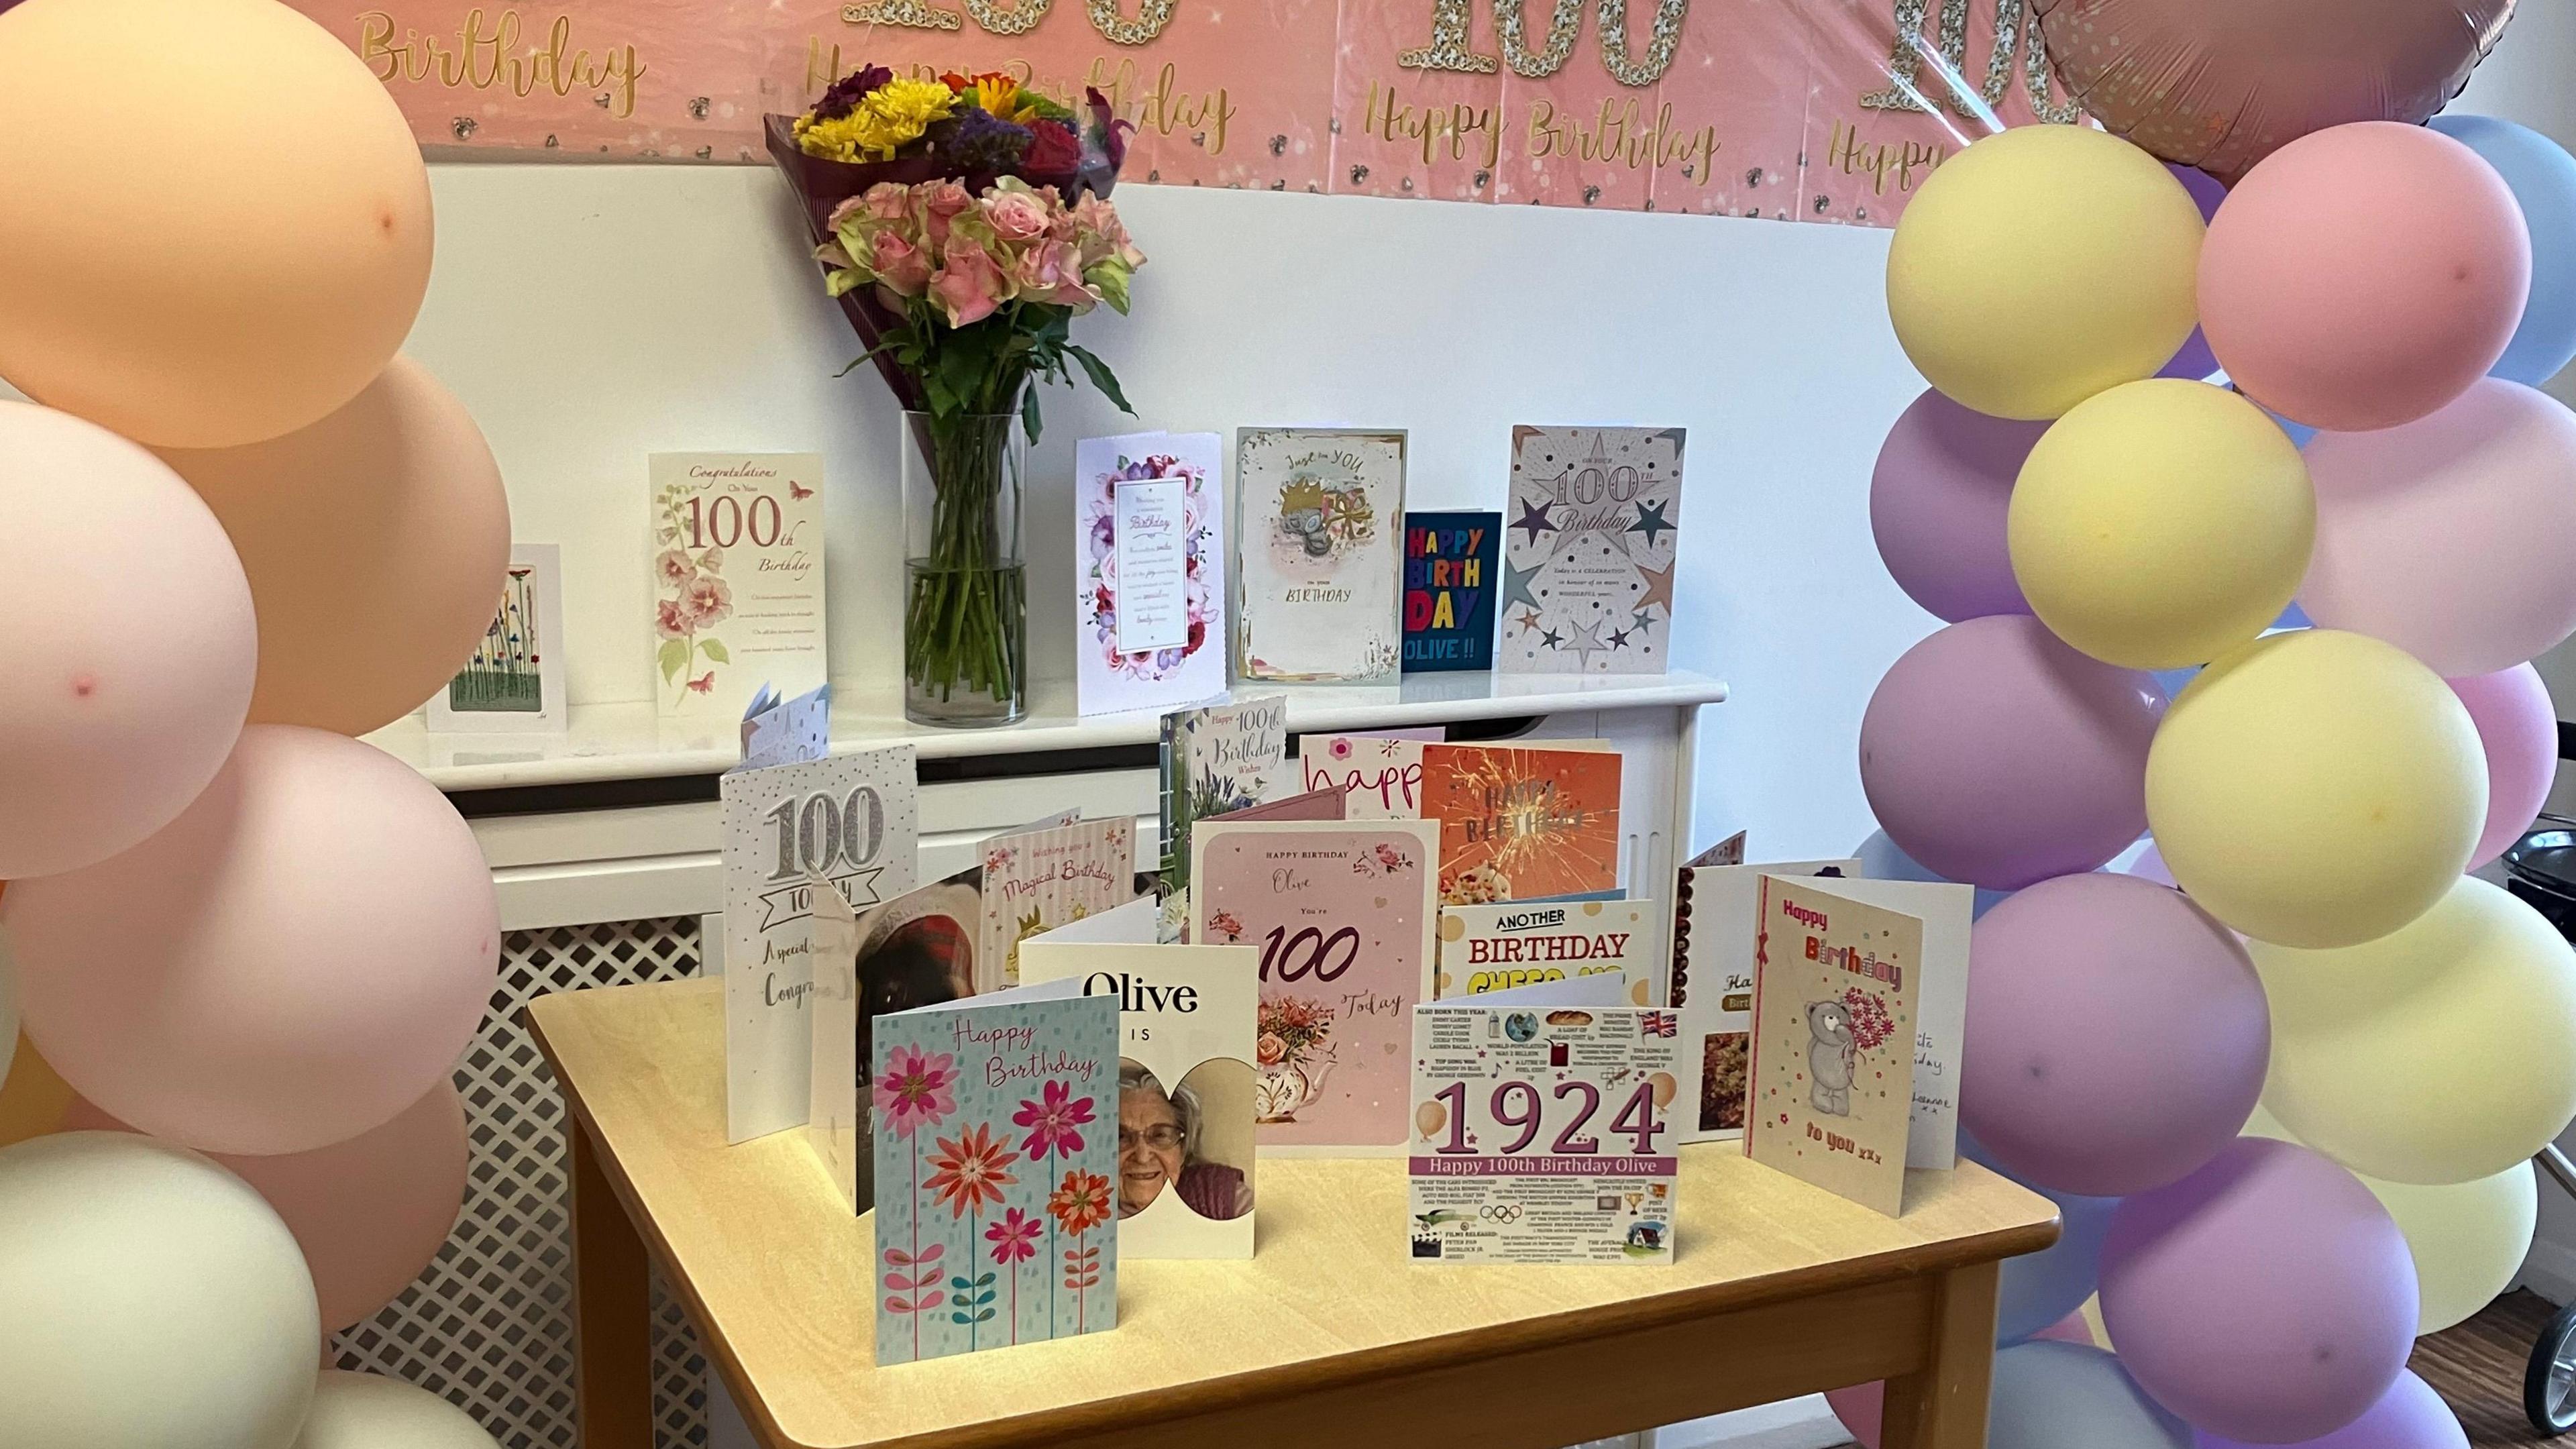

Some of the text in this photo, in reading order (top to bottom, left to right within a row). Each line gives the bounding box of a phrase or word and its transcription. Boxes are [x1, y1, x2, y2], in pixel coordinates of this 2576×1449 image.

[355, 9, 647, 119] Birthday
[1366, 80, 1722, 186] Happy Birthday
[690, 461, 777, 489] Congratulations
[1285, 451, 1315, 470] Just
[1331, 449, 1364, 474] YOU
[1129, 515, 1171, 532] Birthday
[1556, 505, 1633, 537] Birthday
[1407, 527, 1484, 557] HAPPY
[759, 551, 812, 581] Birthday
[1407, 558, 1481, 589] BIRTH
[1286, 588, 1352, 603] BIRTHDAY
[1405, 590, 1479, 632] DAY
[1404, 639, 1458, 660] OLIVE
[1212, 705, 1281, 733] Happy 100th
[1214, 730, 1282, 770] Birthday
[763, 784, 884, 881] 100
[1032, 845, 1065, 859] Wishing
[1266, 851, 1299, 859] HAPPY
[1002, 859, 1115, 902] Magical Birthday
[1272, 868, 1312, 894] Olive
[1496, 909, 1566, 930] ANOTHER
[1783, 899, 1827, 931] Happy
[1258, 924, 1360, 983] 100
[1468, 933, 1630, 964] BIRTHDAY
[1805, 935, 1902, 993] Birthday
[1083, 971, 1198, 1013] Olive
[1340, 988, 1406, 1020] Today
[952, 1018, 1038, 1053] Happy
[985, 1049, 1099, 1088] Birthday
[1434, 1081, 1666, 1155] 1924
[1807, 1121, 1823, 1141] to
[1827, 1130, 1855, 1155] you
[1430, 1157, 1657, 1176] Happy 100th Birthday Olive
